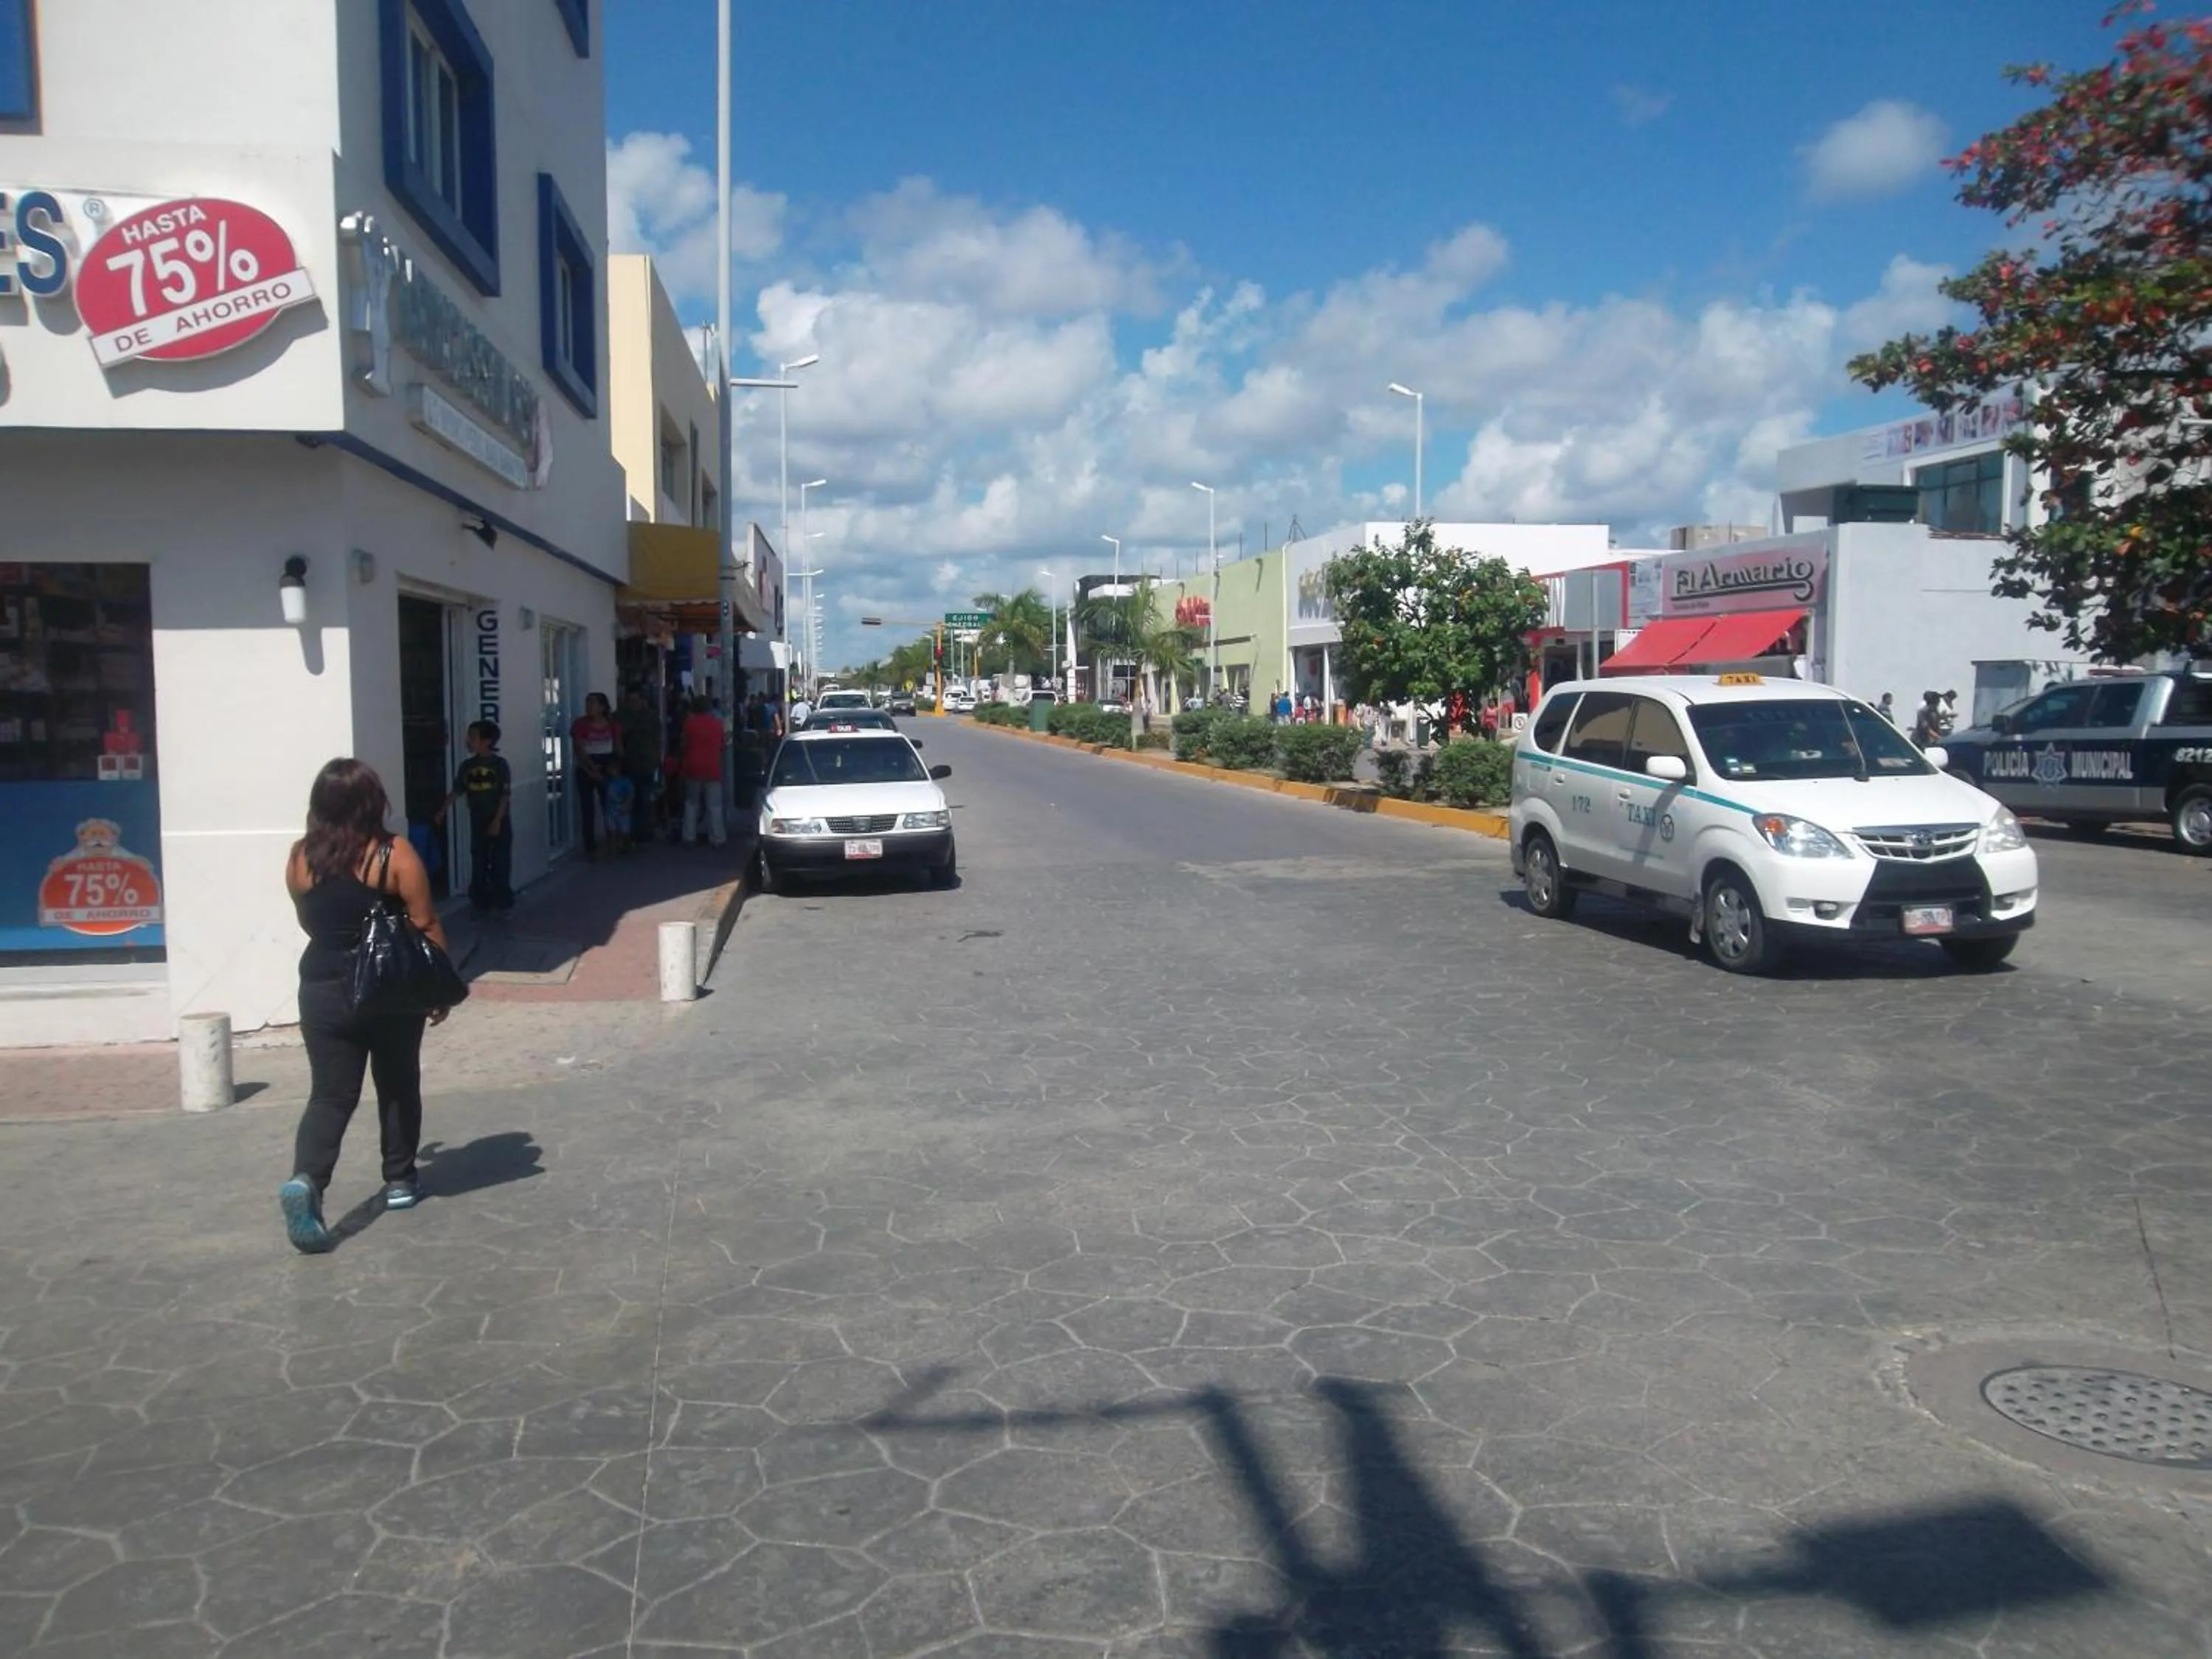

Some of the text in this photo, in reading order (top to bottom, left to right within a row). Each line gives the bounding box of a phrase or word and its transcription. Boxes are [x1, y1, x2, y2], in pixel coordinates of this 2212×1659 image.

[121, 204, 207, 246] HASTA
[0, 190, 67, 296] S
[105, 219, 260, 318] 75%
[114, 281, 292, 353] DE AHORRO
[1674, 557, 1815, 597] El Armario
[476, 610, 500, 737] GENER
[1726, 675, 1756, 683] TAXI
[1983, 745, 2133, 779] POLICÍA MUNICIPAL
[1572, 794, 1591, 814] 172
[1627, 802, 1657, 827] TAXI
[77, 861, 122, 871] HASTA
[64, 871, 139, 906] 75%
[54, 910, 151, 919] DE AHORRO
